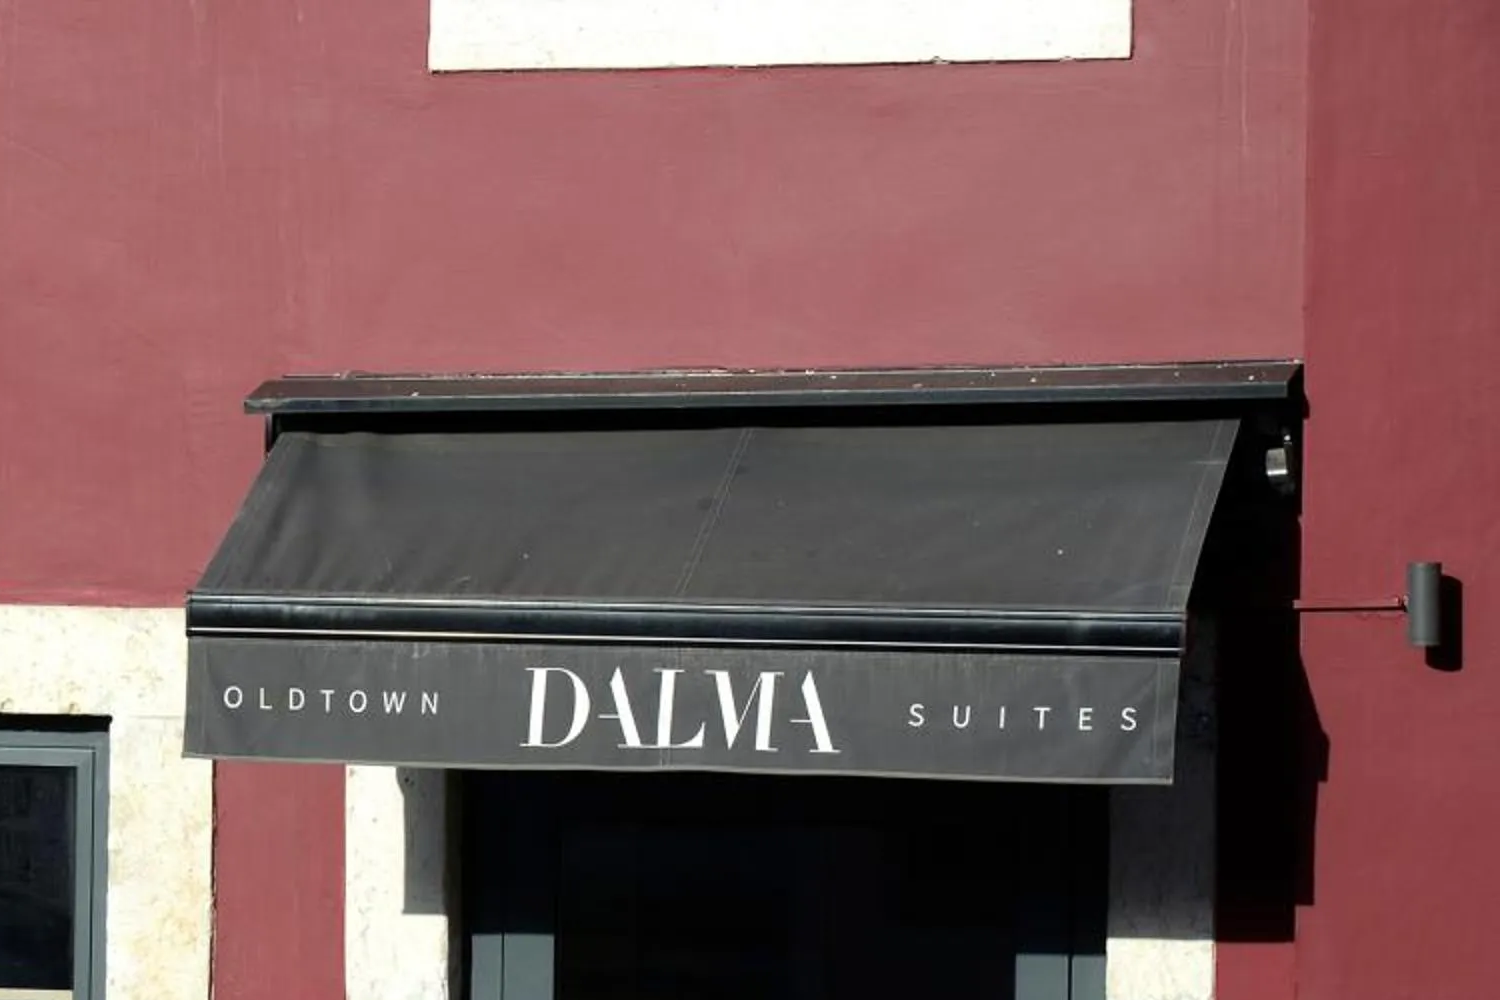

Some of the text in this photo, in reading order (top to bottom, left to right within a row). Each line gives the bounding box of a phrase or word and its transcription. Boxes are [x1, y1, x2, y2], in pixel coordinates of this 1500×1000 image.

[223, 667, 1139, 754] OLDTOWN DALMA SUITES
